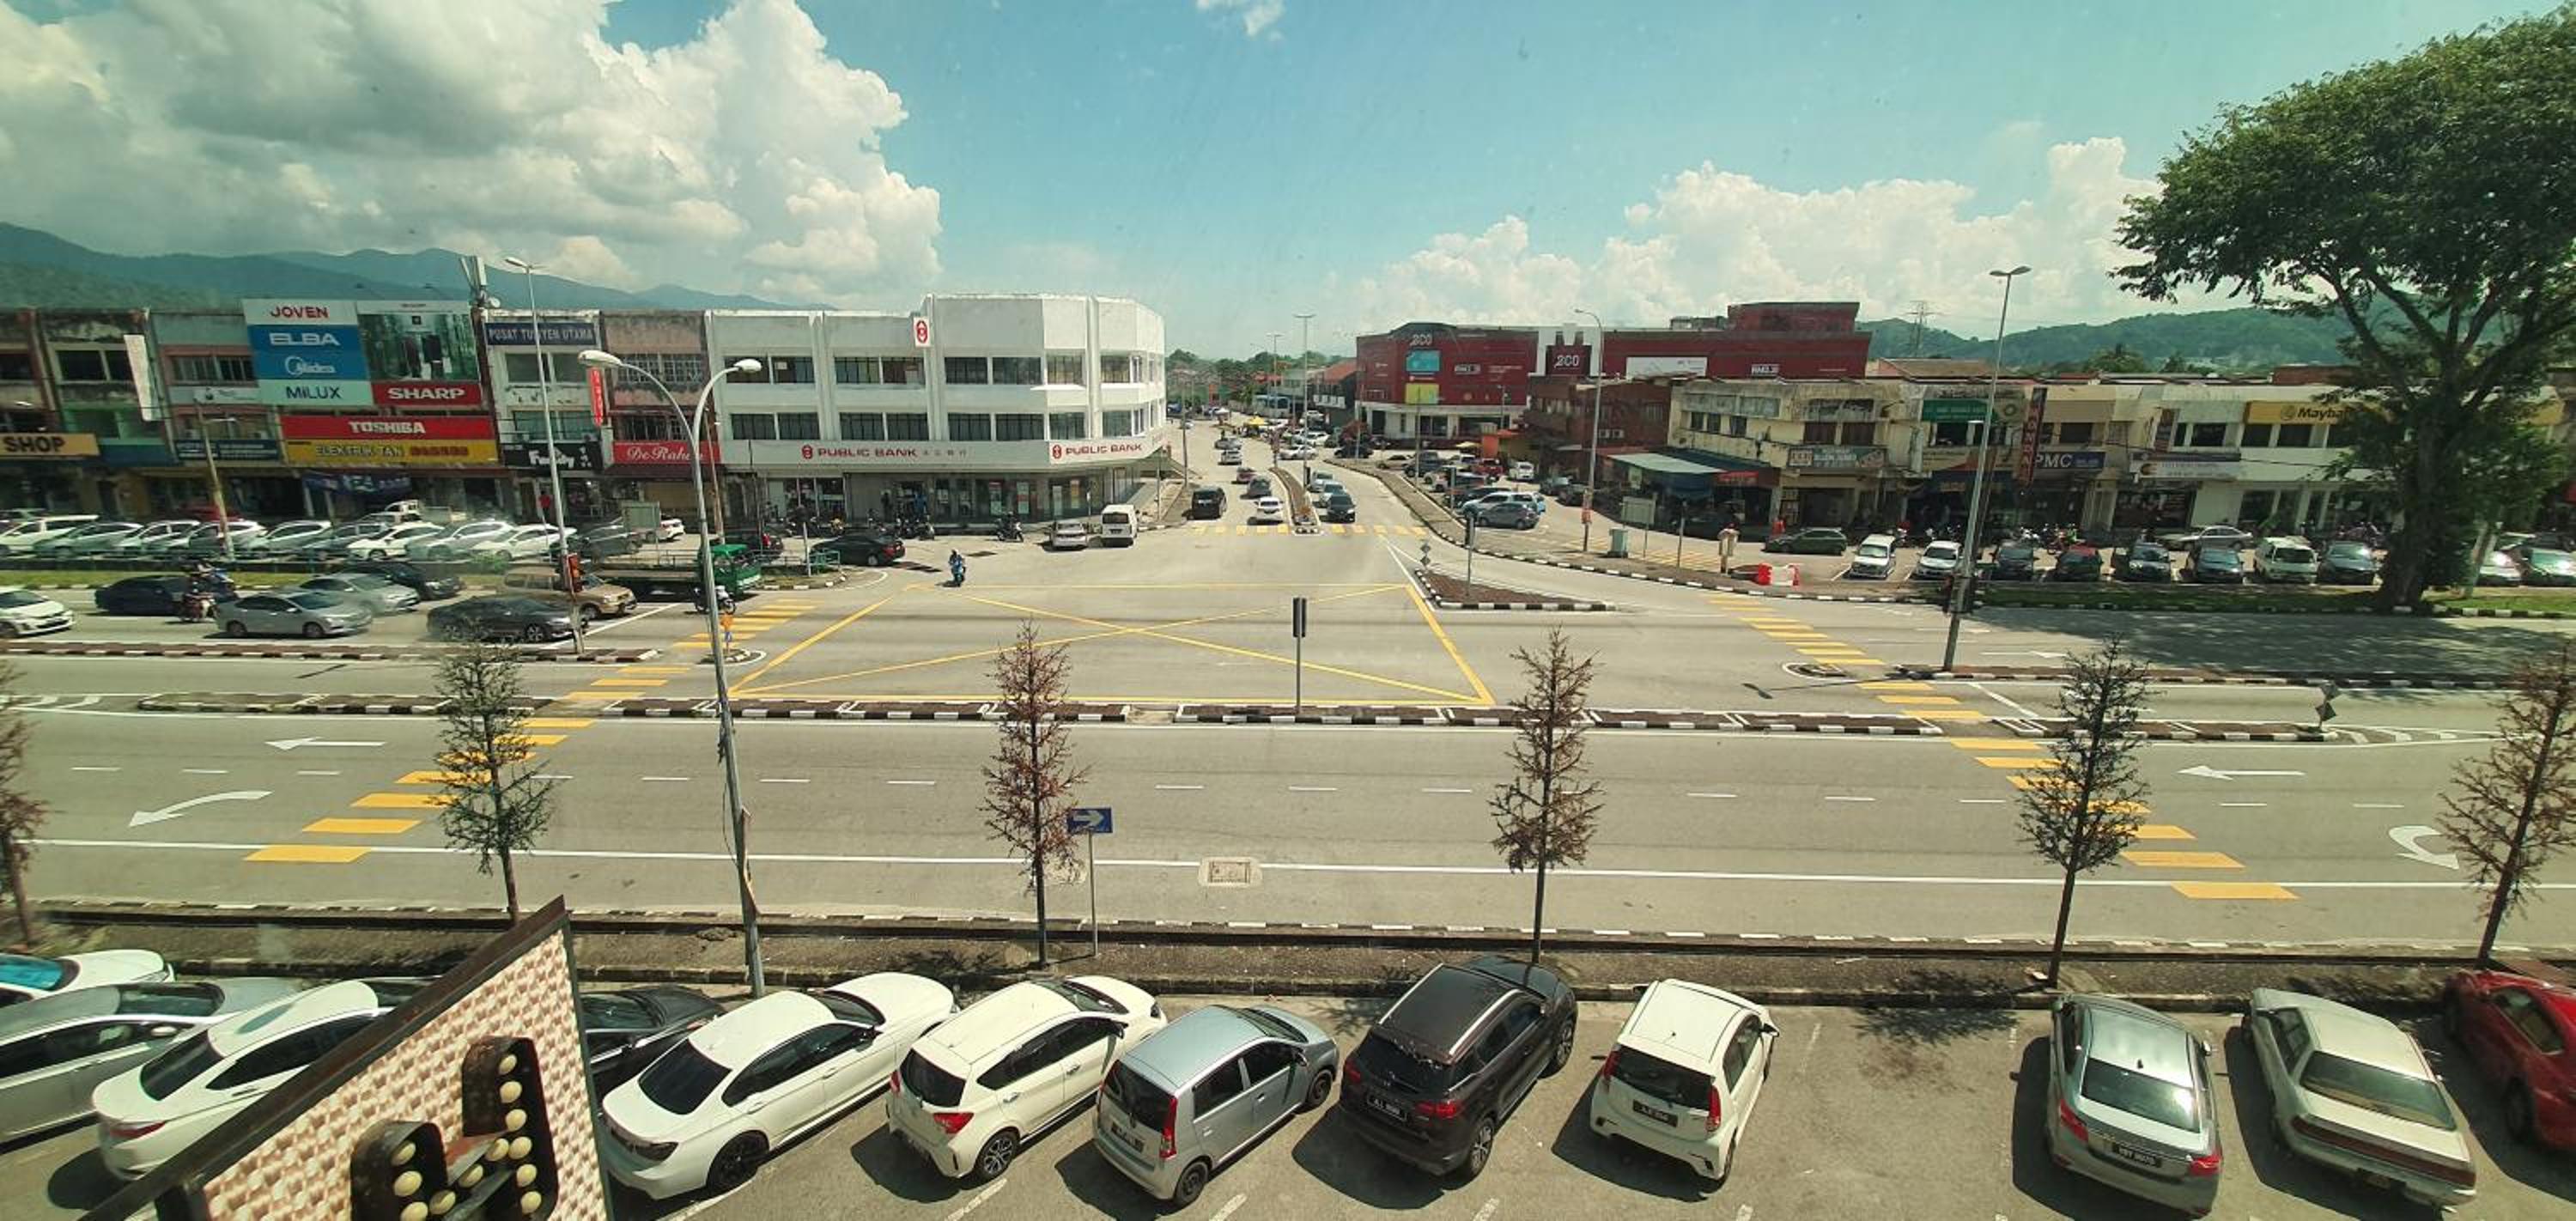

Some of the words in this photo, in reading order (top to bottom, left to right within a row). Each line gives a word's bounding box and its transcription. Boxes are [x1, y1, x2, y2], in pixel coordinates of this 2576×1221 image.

[270, 306, 329, 319] JOVEN
[269, 332, 341, 346] ELBA
[388, 387, 465, 399] SHARP
[2297, 407, 2347, 421] Mayba
[348, 422, 426, 434] TOSHIBA
[3, 436, 65, 453] SHOP
[1066, 445, 1109, 455] PUBLIC
[1110, 444, 1143, 453] BANK
[817, 447, 870, 458] PUBLIC
[875, 447, 918, 458] BANK
